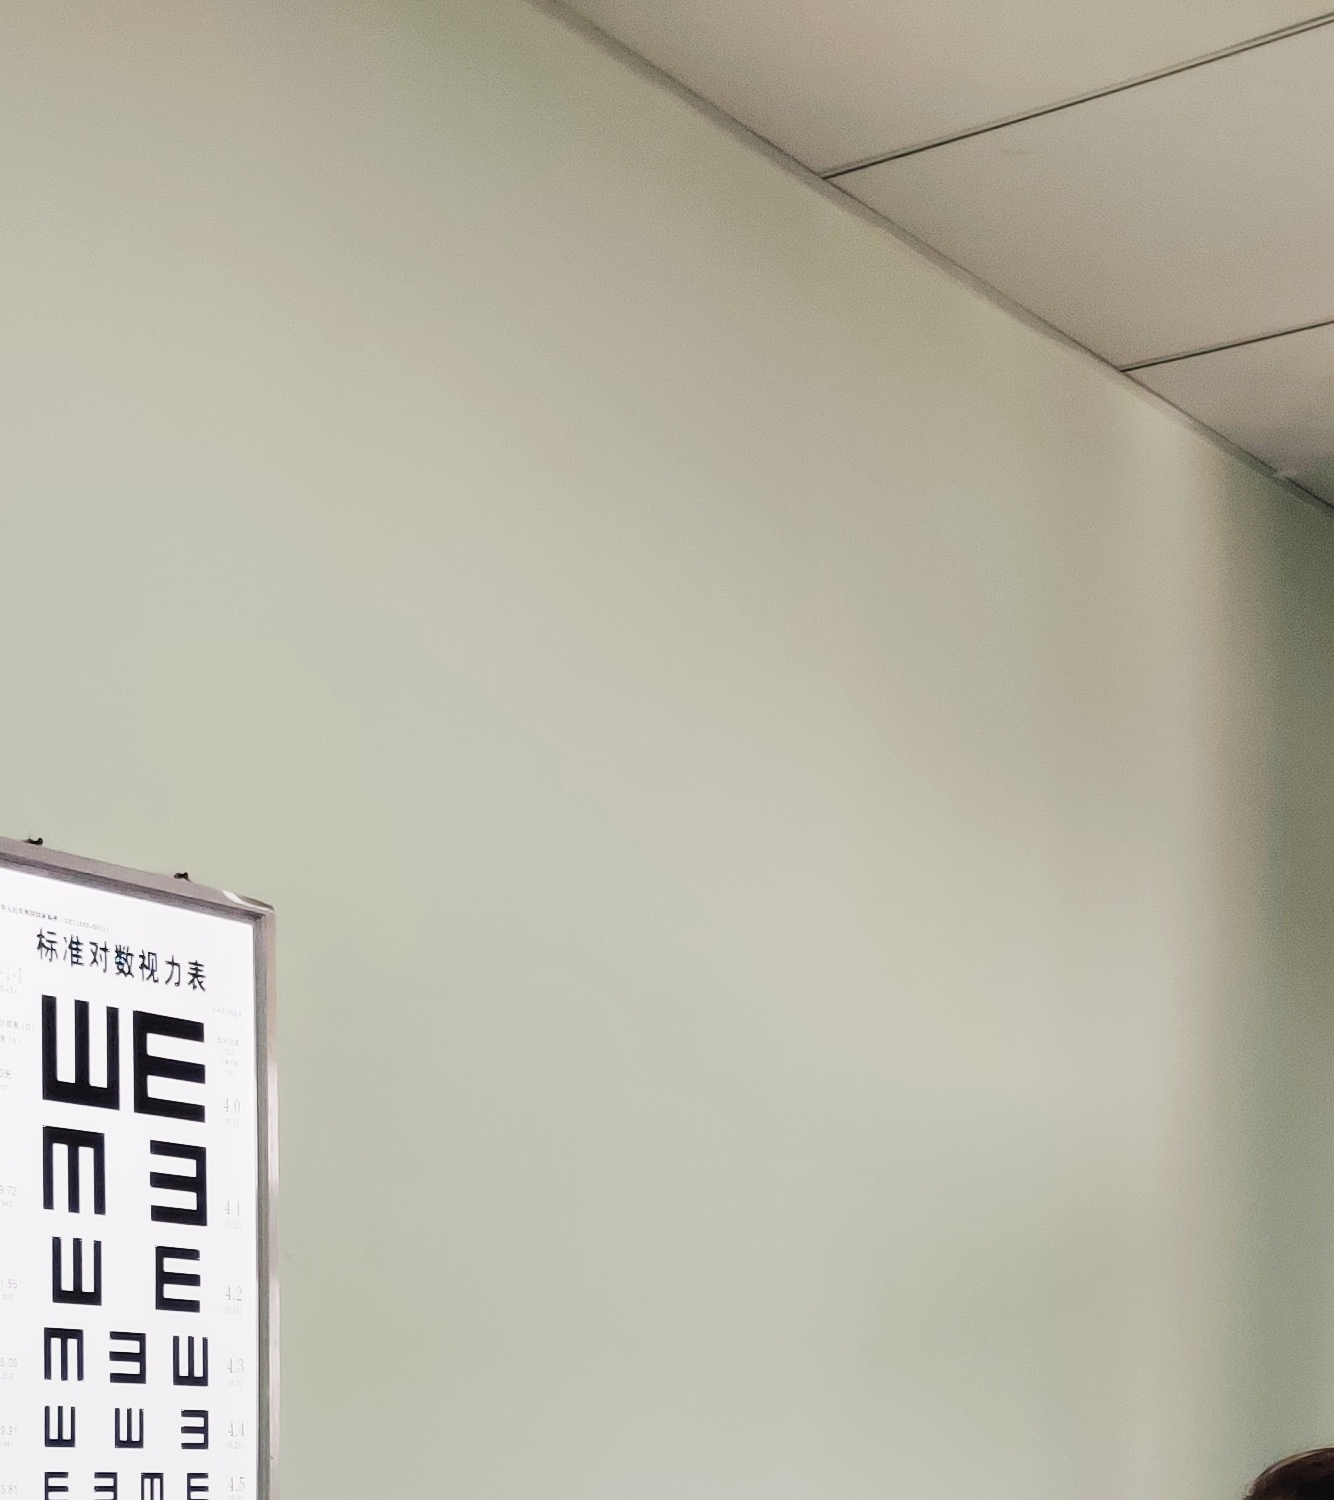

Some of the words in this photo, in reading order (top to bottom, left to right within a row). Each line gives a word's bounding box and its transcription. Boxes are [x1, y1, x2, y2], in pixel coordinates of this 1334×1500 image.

[35, 926, 207, 993] 标准对数视力表
[222, 1096, 241, 1114] 4.0
[223, 1199, 241, 1217] 4.1
[224, 1285, 243, 1302] 4.2
[226, 1357, 245, 1374] 4.3
[227, 1475, 246, 1493] 4.5
